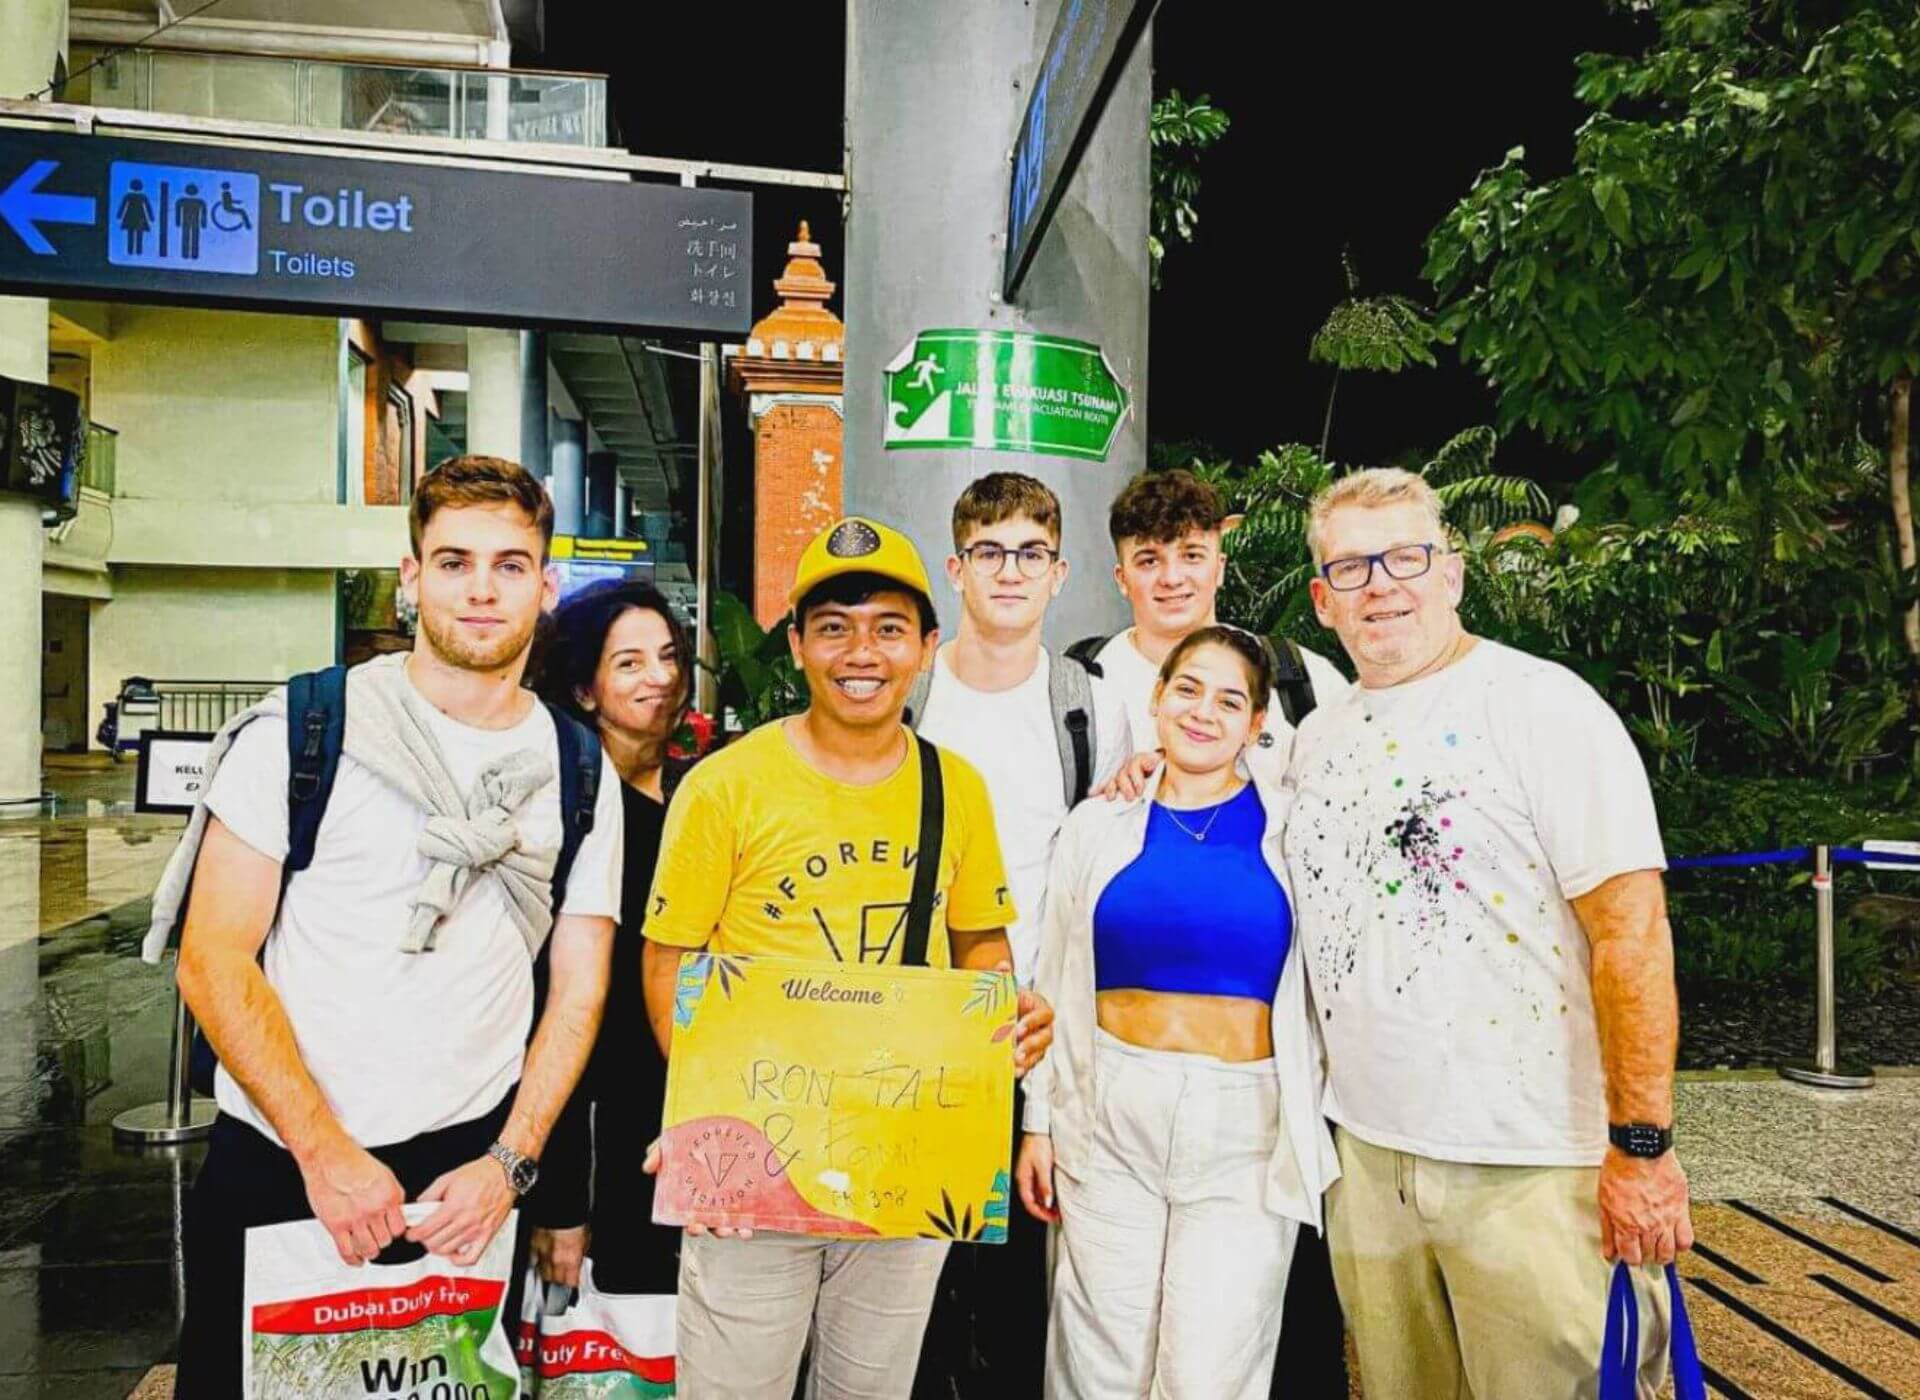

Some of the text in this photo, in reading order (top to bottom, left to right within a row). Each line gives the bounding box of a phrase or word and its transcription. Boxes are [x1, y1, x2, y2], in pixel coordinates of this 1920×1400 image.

[269, 183, 413, 232] Toilet
[268, 250, 355, 278] Toilets
[781, 977, 885, 1006] Welcome
[763, 1111, 804, 1178] &
[314, 1302, 385, 1325] Dubai
[361, 1353, 448, 1393] Win
